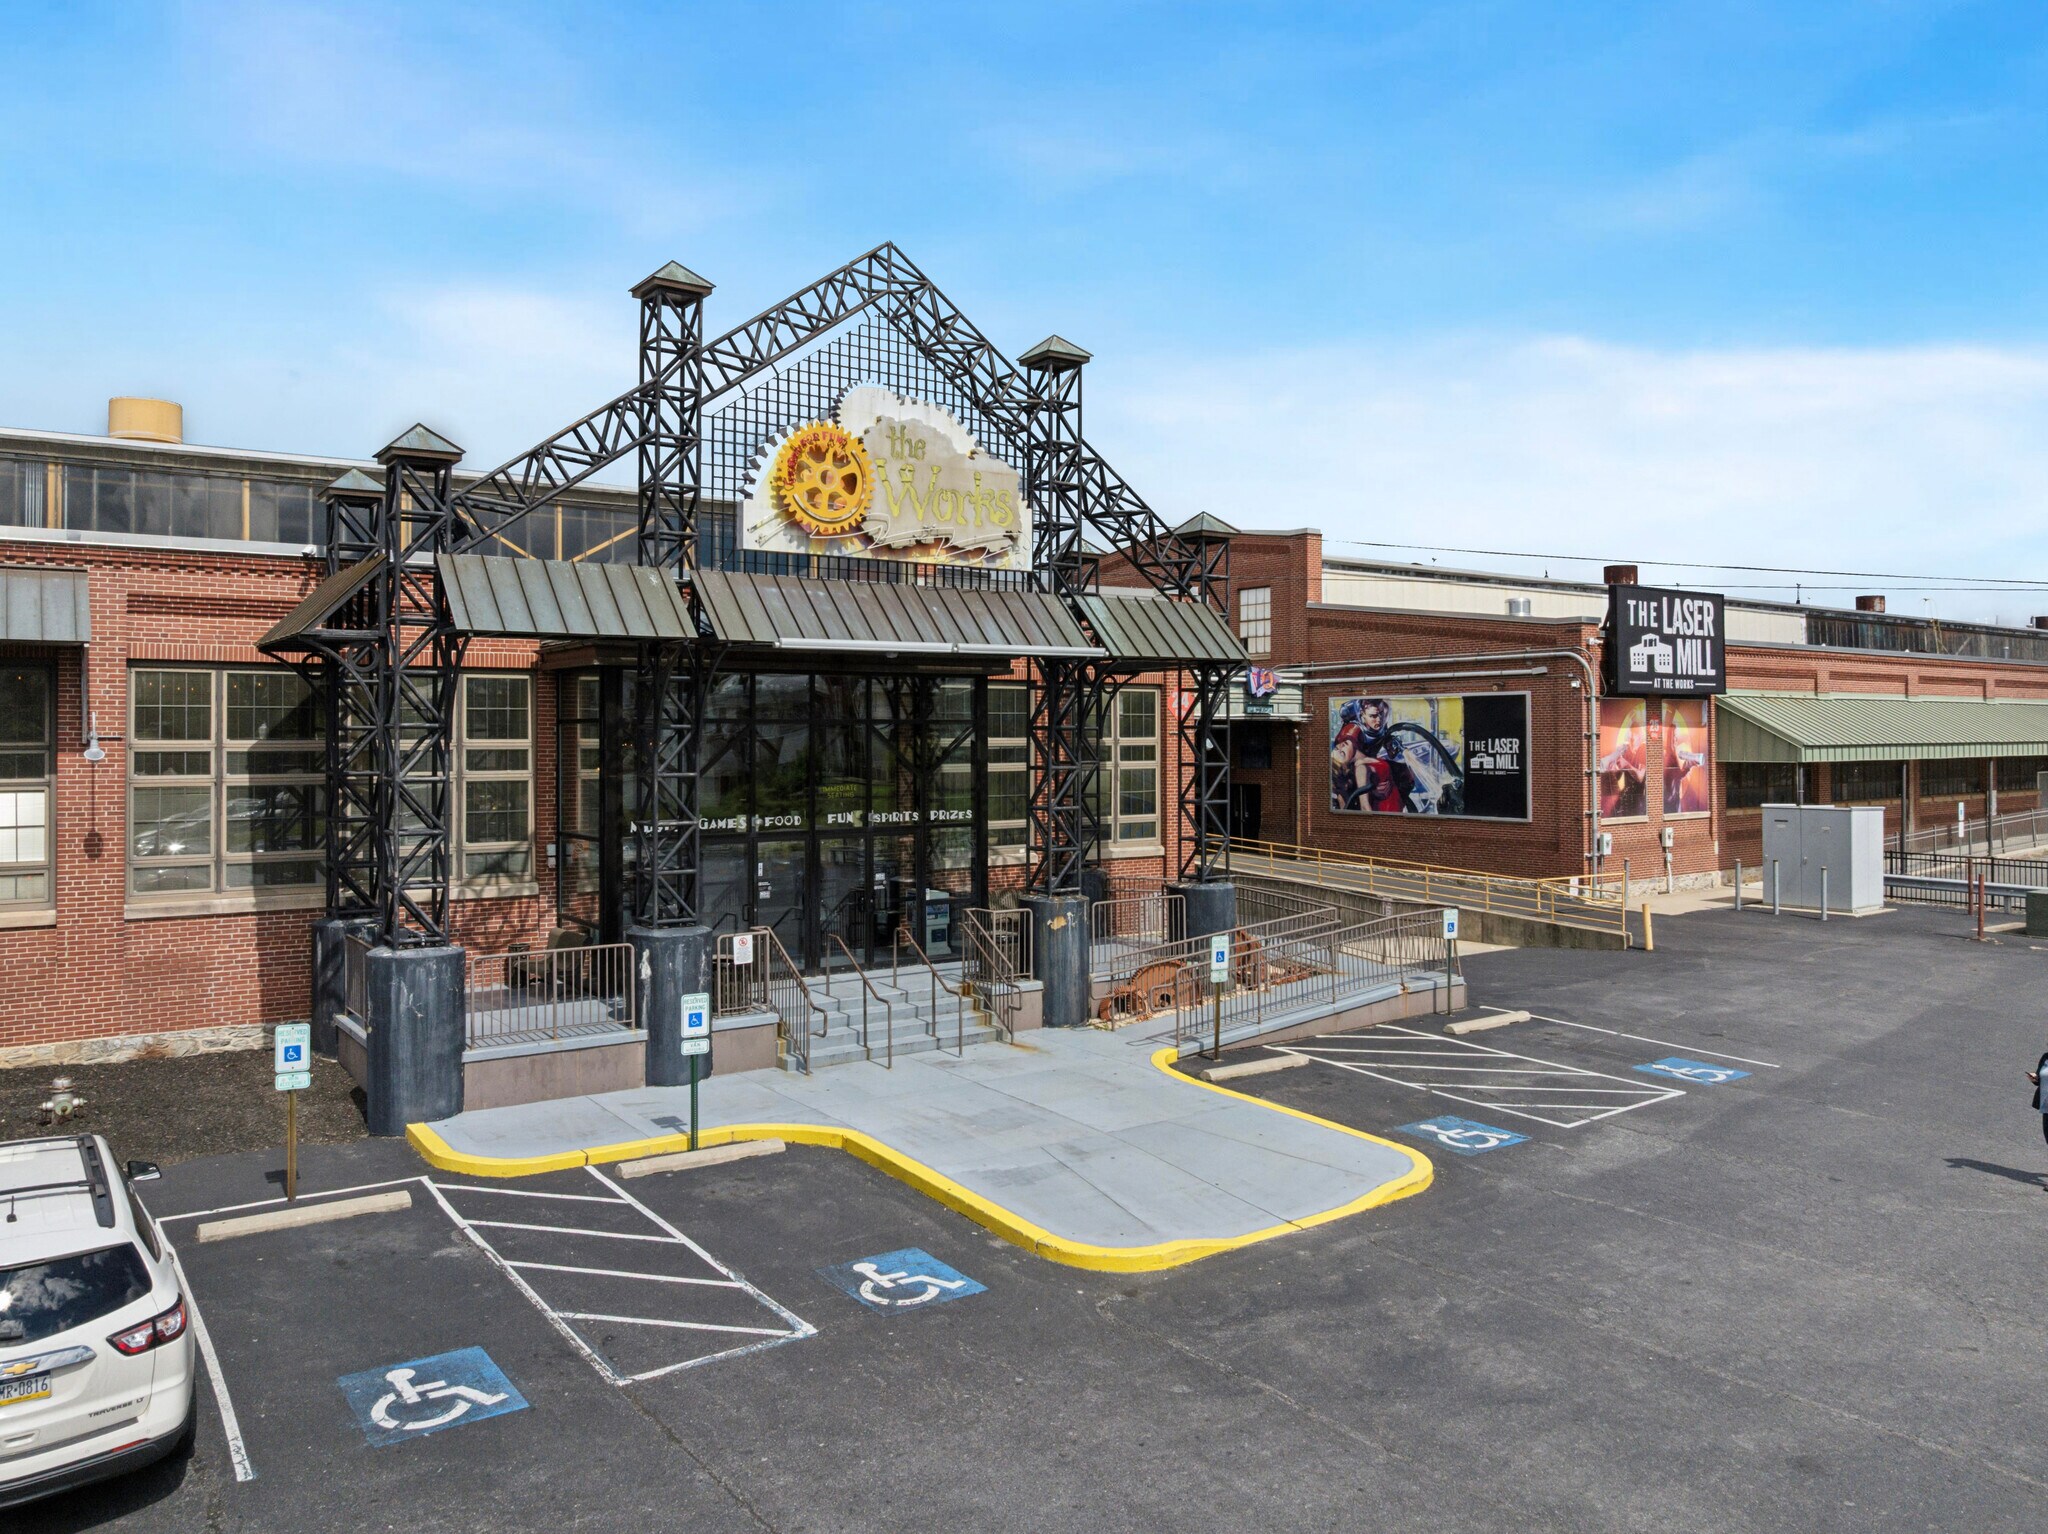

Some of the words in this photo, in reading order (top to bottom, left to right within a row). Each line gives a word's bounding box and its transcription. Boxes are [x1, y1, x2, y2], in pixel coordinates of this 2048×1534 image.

[885, 424, 926, 461] the
[874, 458, 1014, 527] Works
[1627, 599, 1658, 628] THE
[1662, 596, 1715, 637] LASER
[1677, 638, 1716, 676] MILL
[1653, 678, 1661, 688] AT
[1662, 678, 1673, 689] THE
[1674, 679, 1694, 689] WORKS
[1469, 740, 1486, 751] THE
[1488, 737, 1519, 753] LASER
[1496, 754, 1519, 769] MILL
[822, 783, 857, 793] IMMEDIATE
[827, 791, 855, 799] SEATING
[699, 817, 747, 830] GAMES
[764, 815, 802, 827] FOOD
[827, 812, 854, 824] FUN
[873, 811, 919, 823] SPIRITS
[930, 809, 973, 821] PRIZES
[88, 1400, 133, 1418] TRAVERSE
